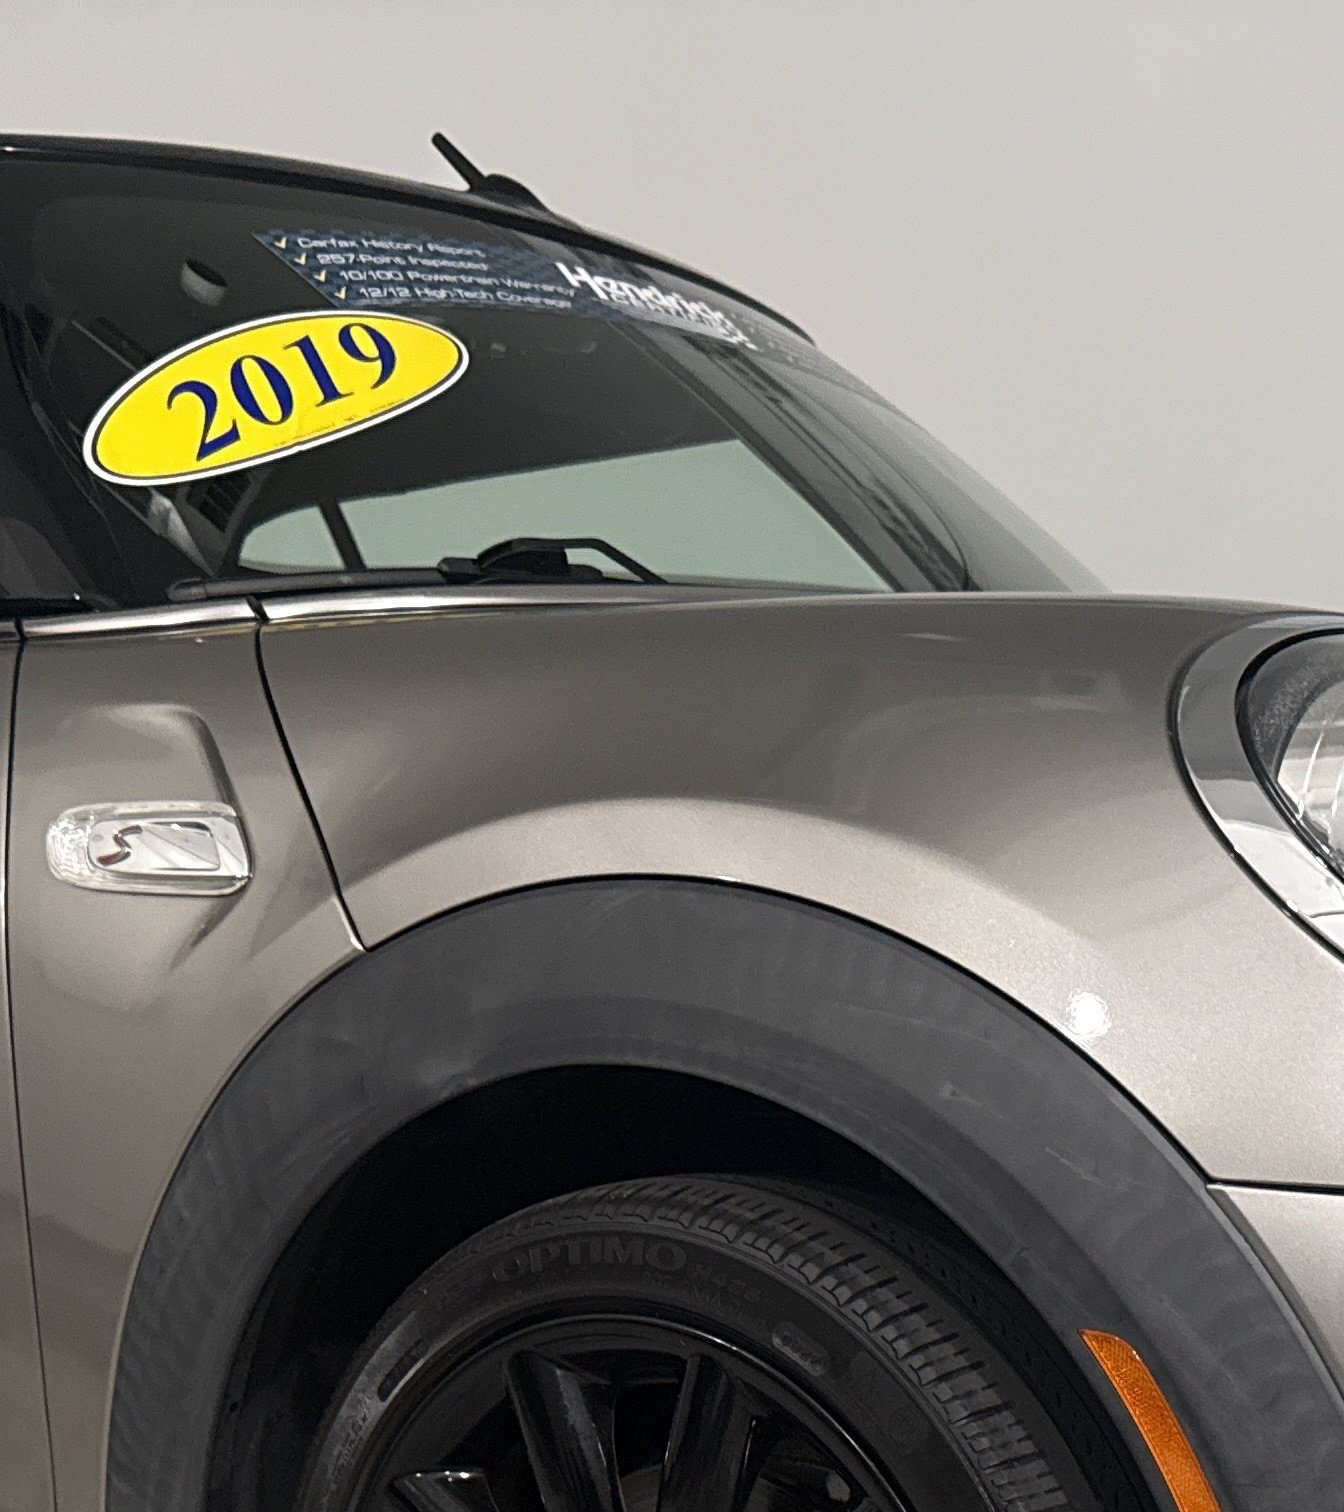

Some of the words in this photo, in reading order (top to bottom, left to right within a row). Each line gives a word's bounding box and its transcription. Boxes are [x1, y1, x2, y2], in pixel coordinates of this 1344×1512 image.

[297, 236, 358, 249] Carfax
[361, 237, 423, 253] History
[339, 269, 403, 282] 10/100
[359, 285, 411, 298] 12/12
[165, 321, 398, 462] 2019
[491, 1236, 688, 1283] OPTIMO
